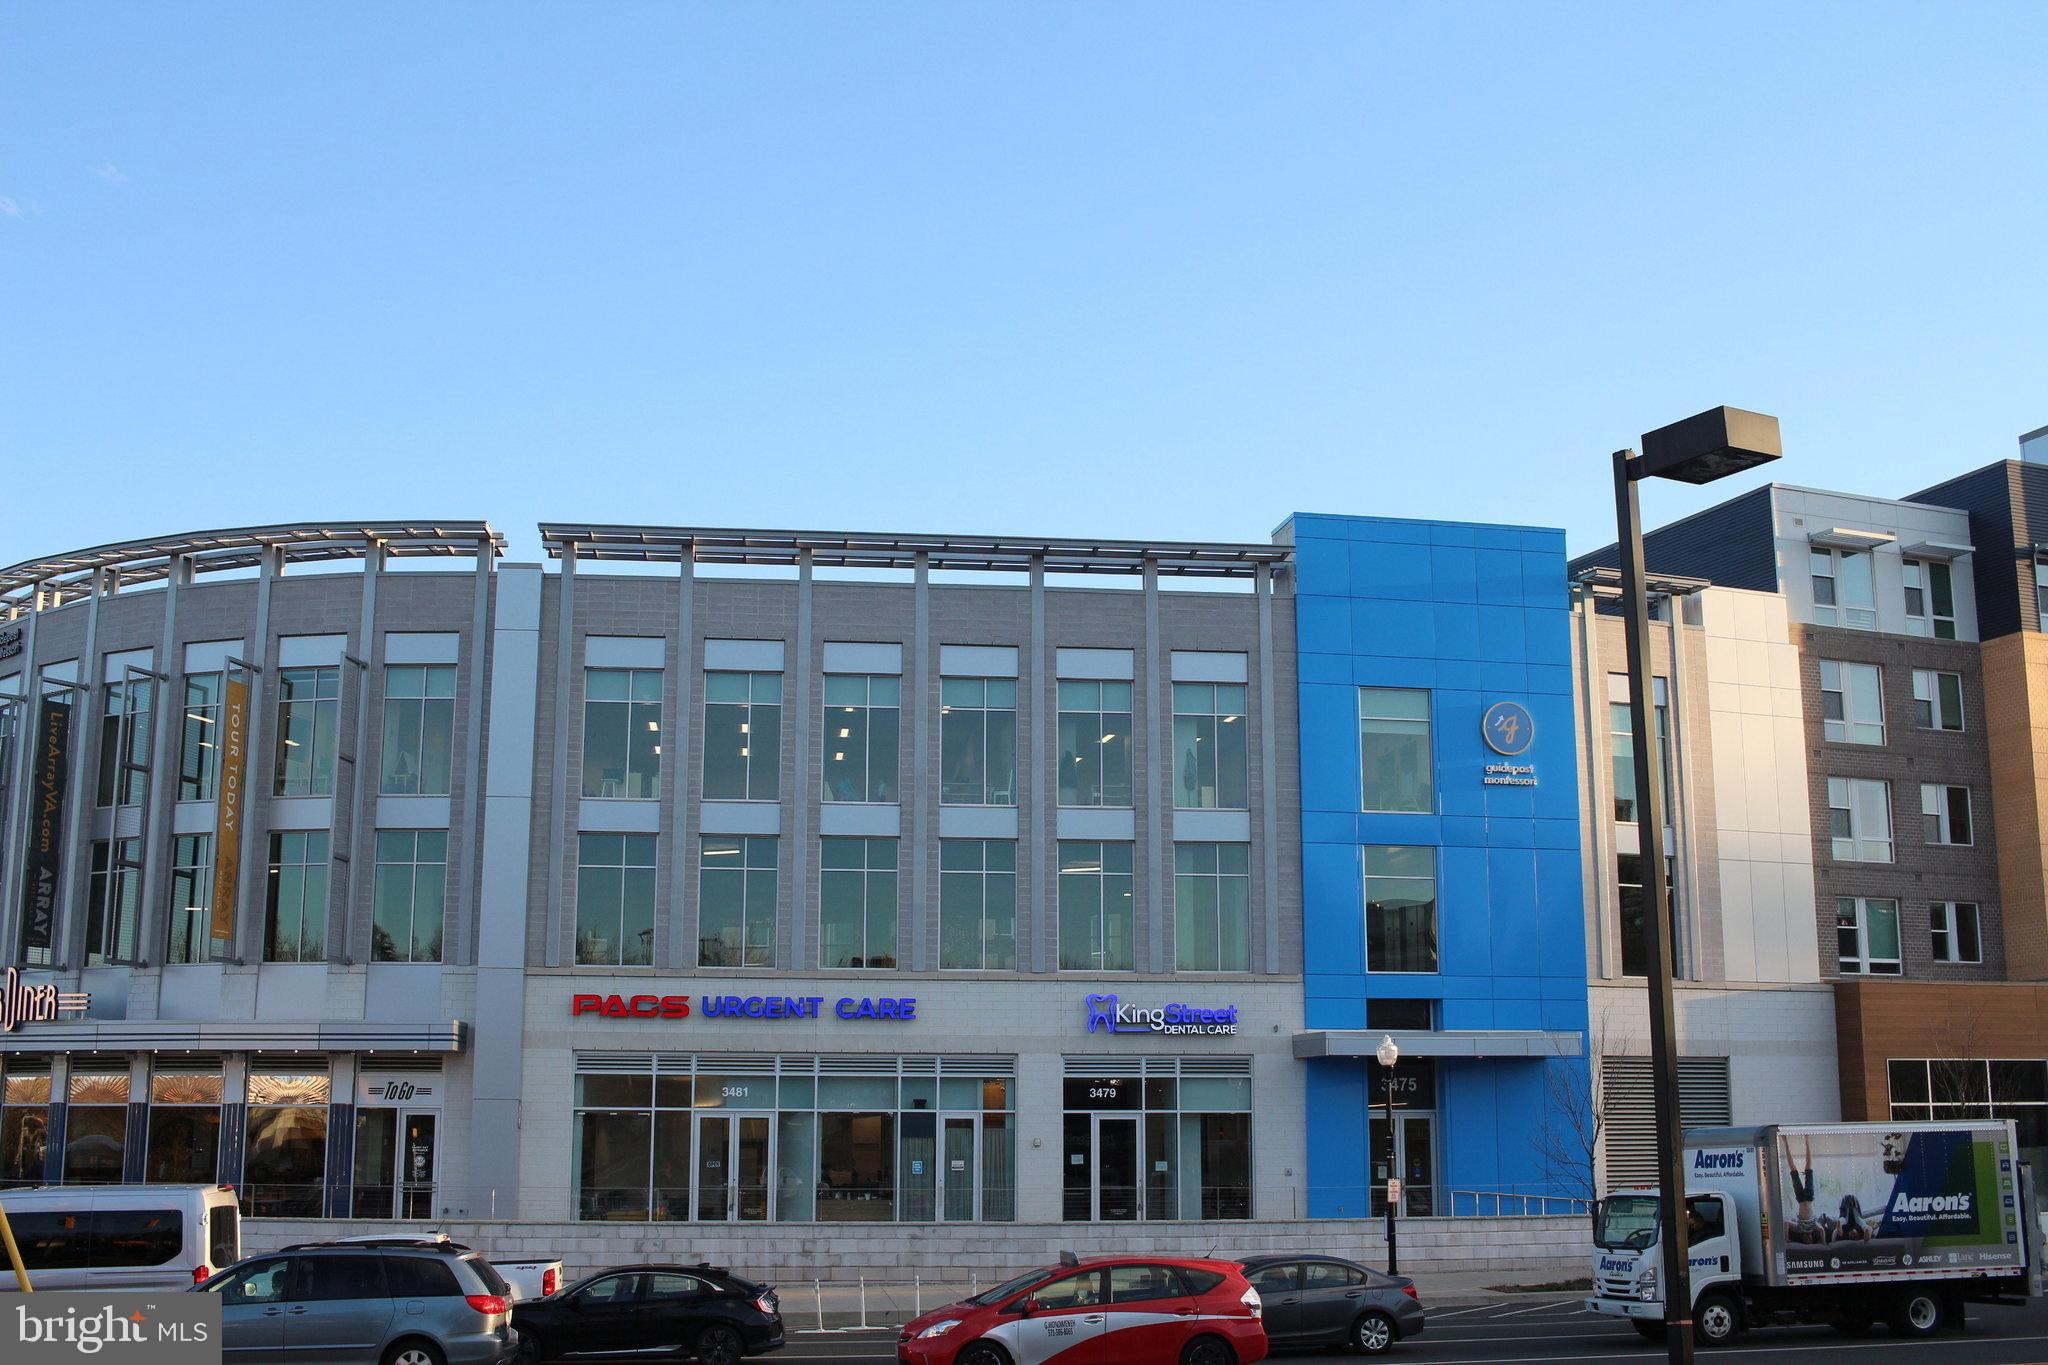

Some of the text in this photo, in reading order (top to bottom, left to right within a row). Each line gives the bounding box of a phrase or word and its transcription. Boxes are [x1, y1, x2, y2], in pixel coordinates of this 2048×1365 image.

[225, 703, 241, 831] TOUR TODAY
[1485, 762, 1535, 775] guidepost
[41, 711, 64, 853] LiveArrayVA.com
[1484, 776, 1538, 786] montessori
[33, 866, 53, 937] ARRAY
[573, 994, 917, 1020] PACS URGENT CARE
[1115, 1003, 1238, 1030] KingStreet
[1164, 1025, 1237, 1034] DENTAL CARE
[1381, 1077, 1417, 1091] 3475
[721, 1086, 749, 1097] 3481
[1089, 1088, 1117, 1098] 3479
[1694, 1149, 1744, 1169] Aaron's
[1892, 1192, 1970, 1212] Aaron's
[1938, 1212, 1972, 1220] Affordable.
[1688, 1256, 1719, 1267] aron's
[1918, 1255, 1942, 1264] ASHLEY
[1979, 1252, 2012, 1261] Hisense
[1600, 1255, 1633, 1273] Aaron's
[1786, 1260, 1824, 1269] SAMSUNG
